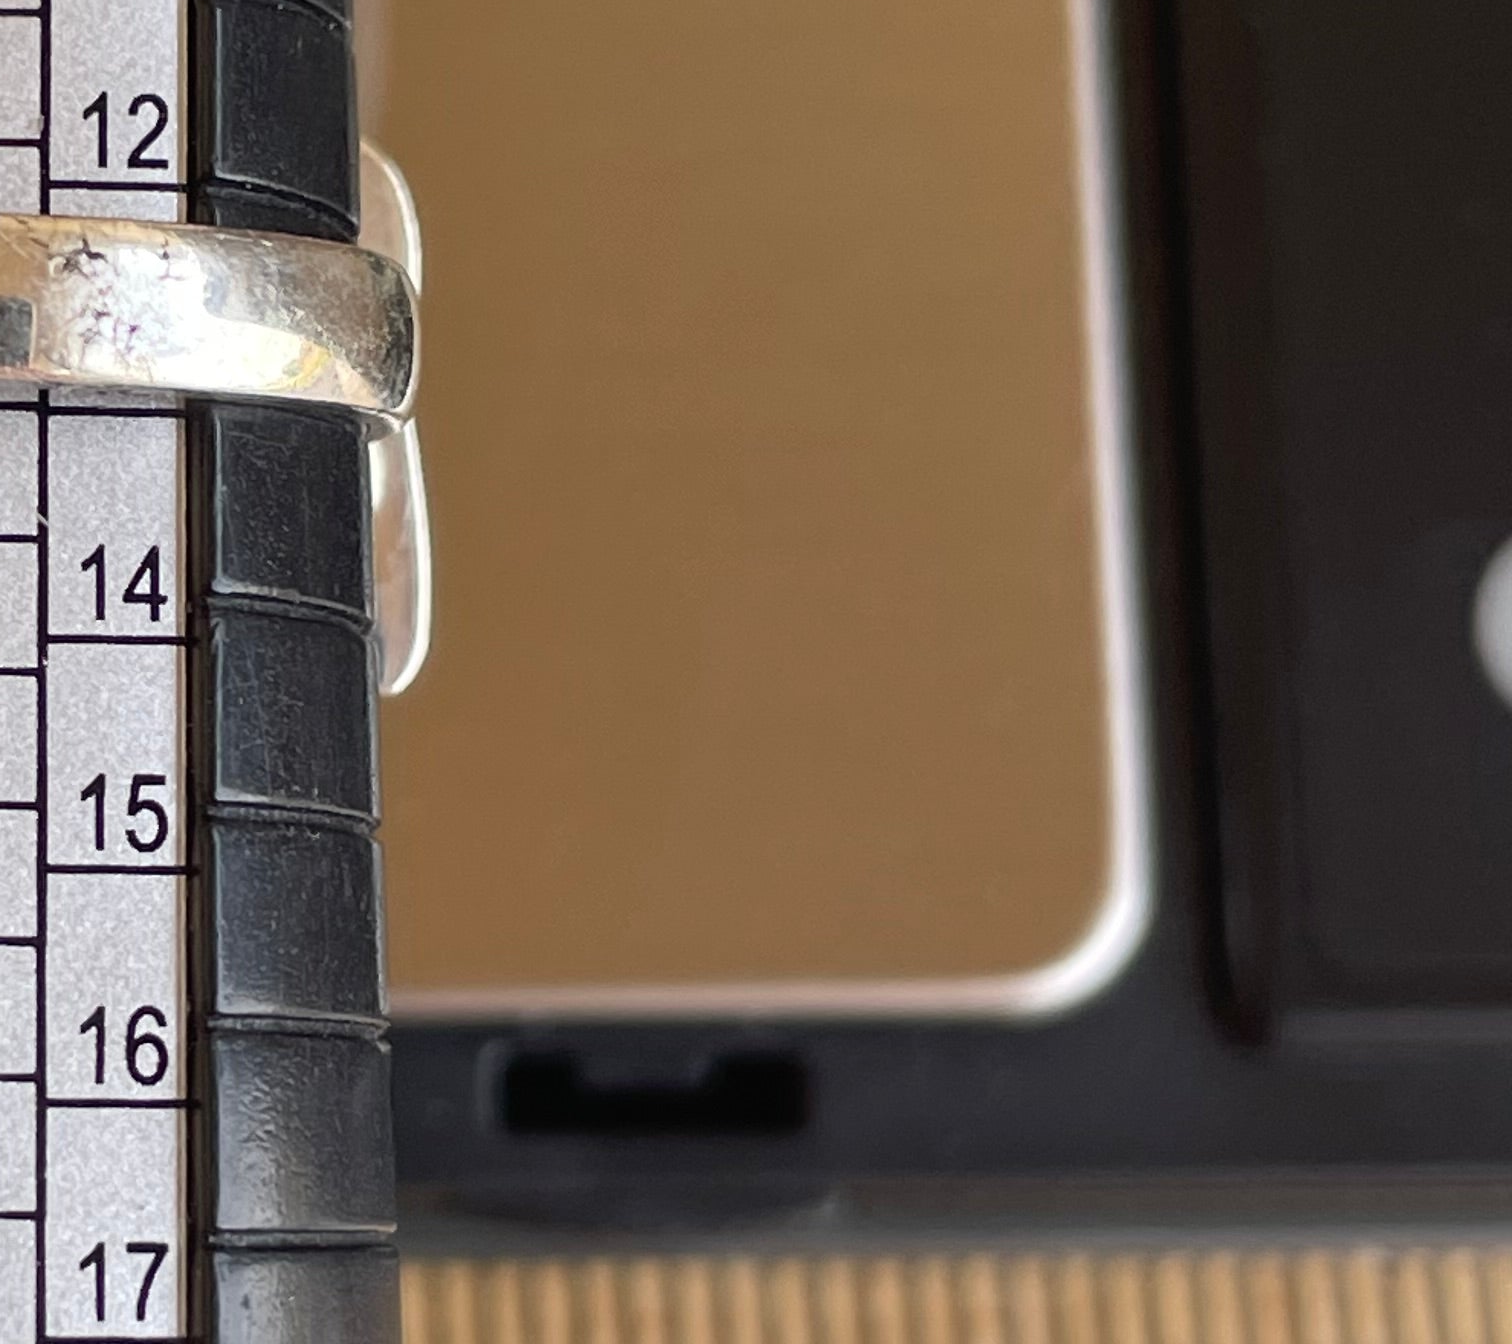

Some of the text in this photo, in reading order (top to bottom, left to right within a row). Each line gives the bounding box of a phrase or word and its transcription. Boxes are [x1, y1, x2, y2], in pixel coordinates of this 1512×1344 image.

[83, 91, 168, 169] 12
[81, 544, 167, 622] 14
[81, 774, 168, 852] 15
[81, 1006, 168, 1086] 16
[80, 1243, 168, 1321] 17
